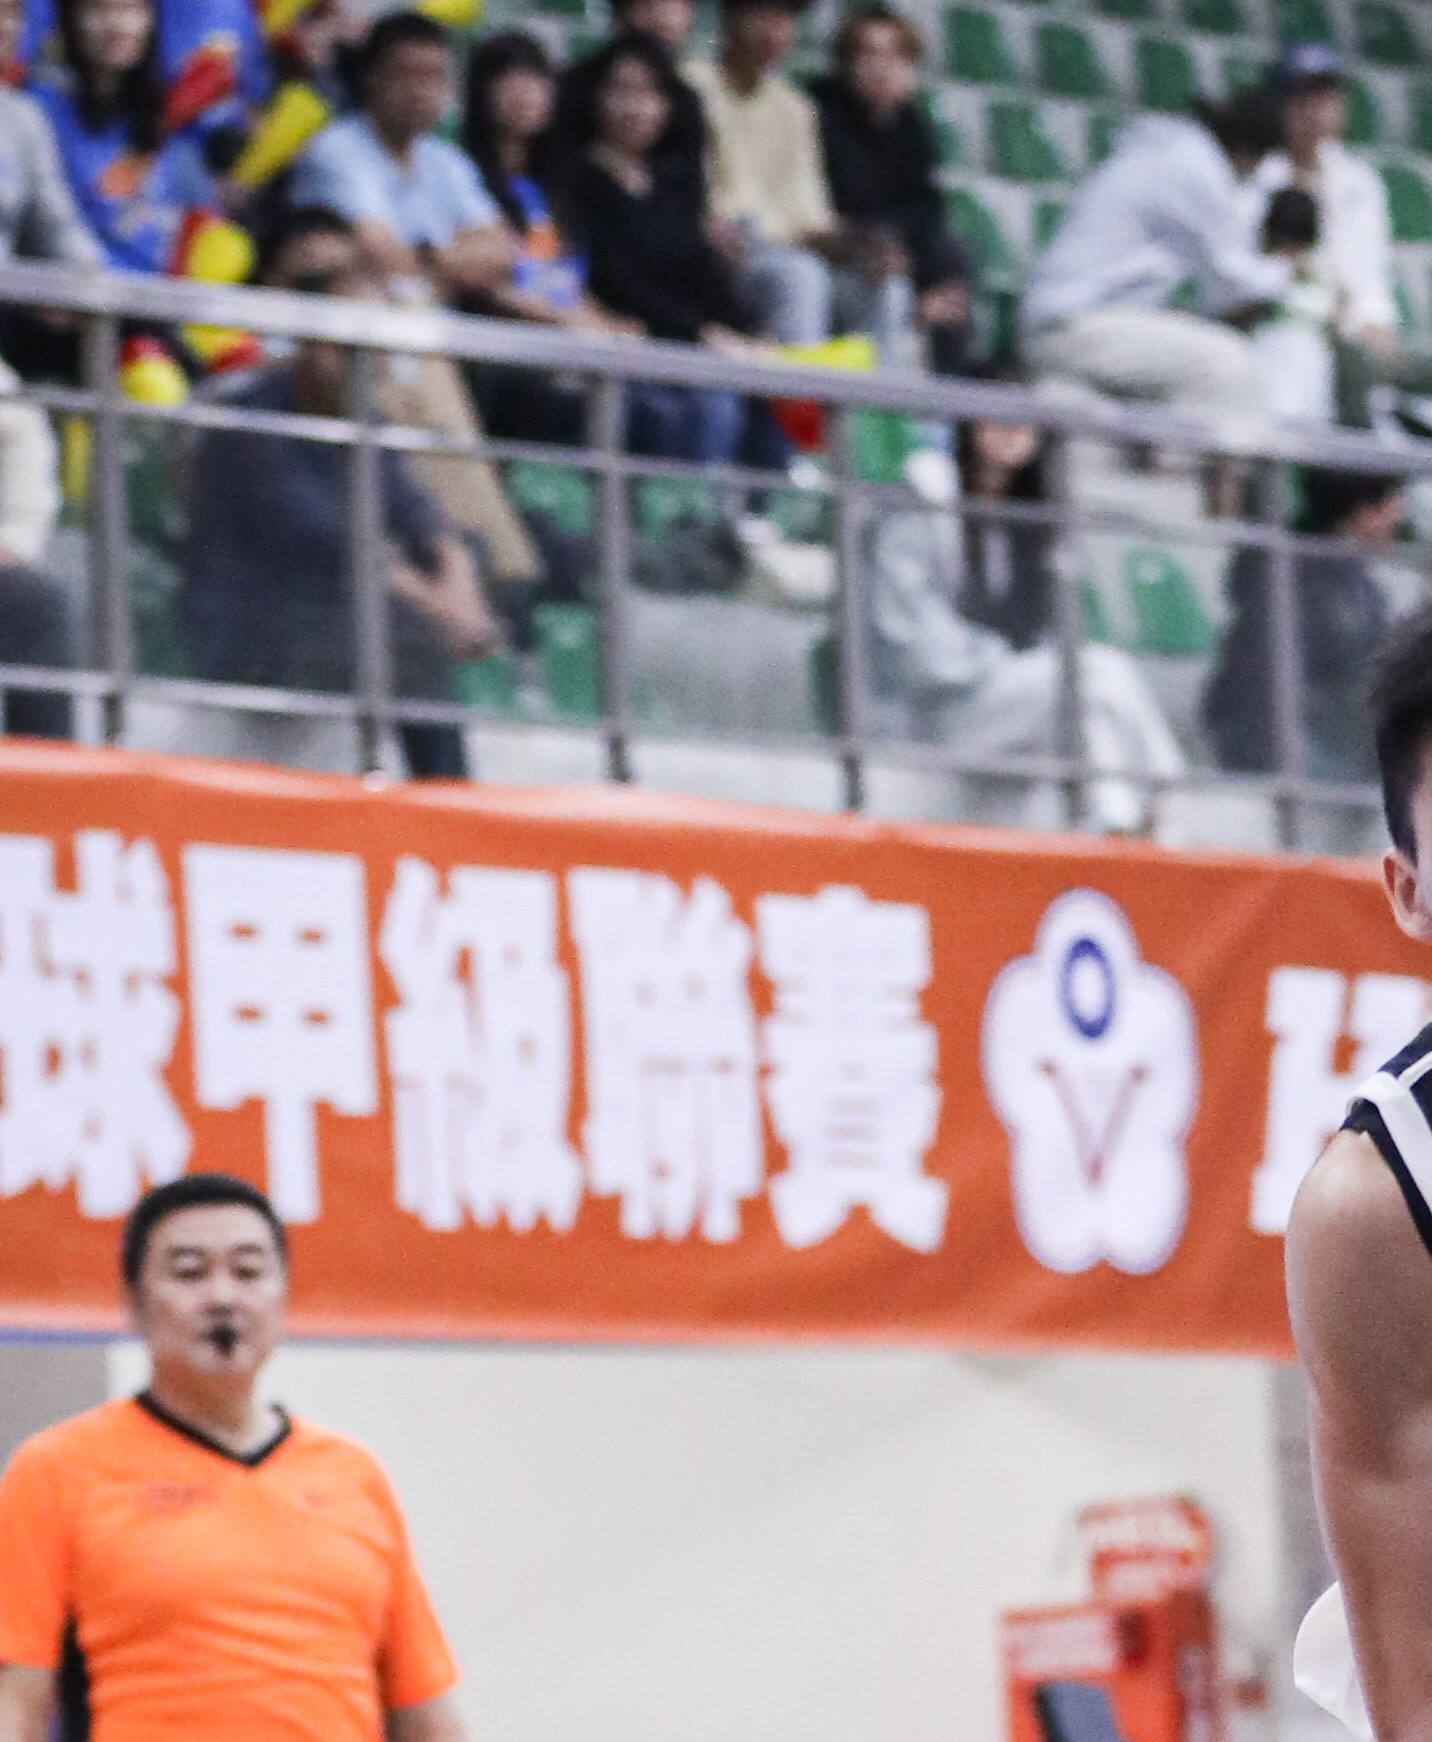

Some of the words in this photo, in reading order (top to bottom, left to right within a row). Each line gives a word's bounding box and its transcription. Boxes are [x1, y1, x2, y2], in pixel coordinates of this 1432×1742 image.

[0, 828, 949, 1254] 球甲級聯賽
